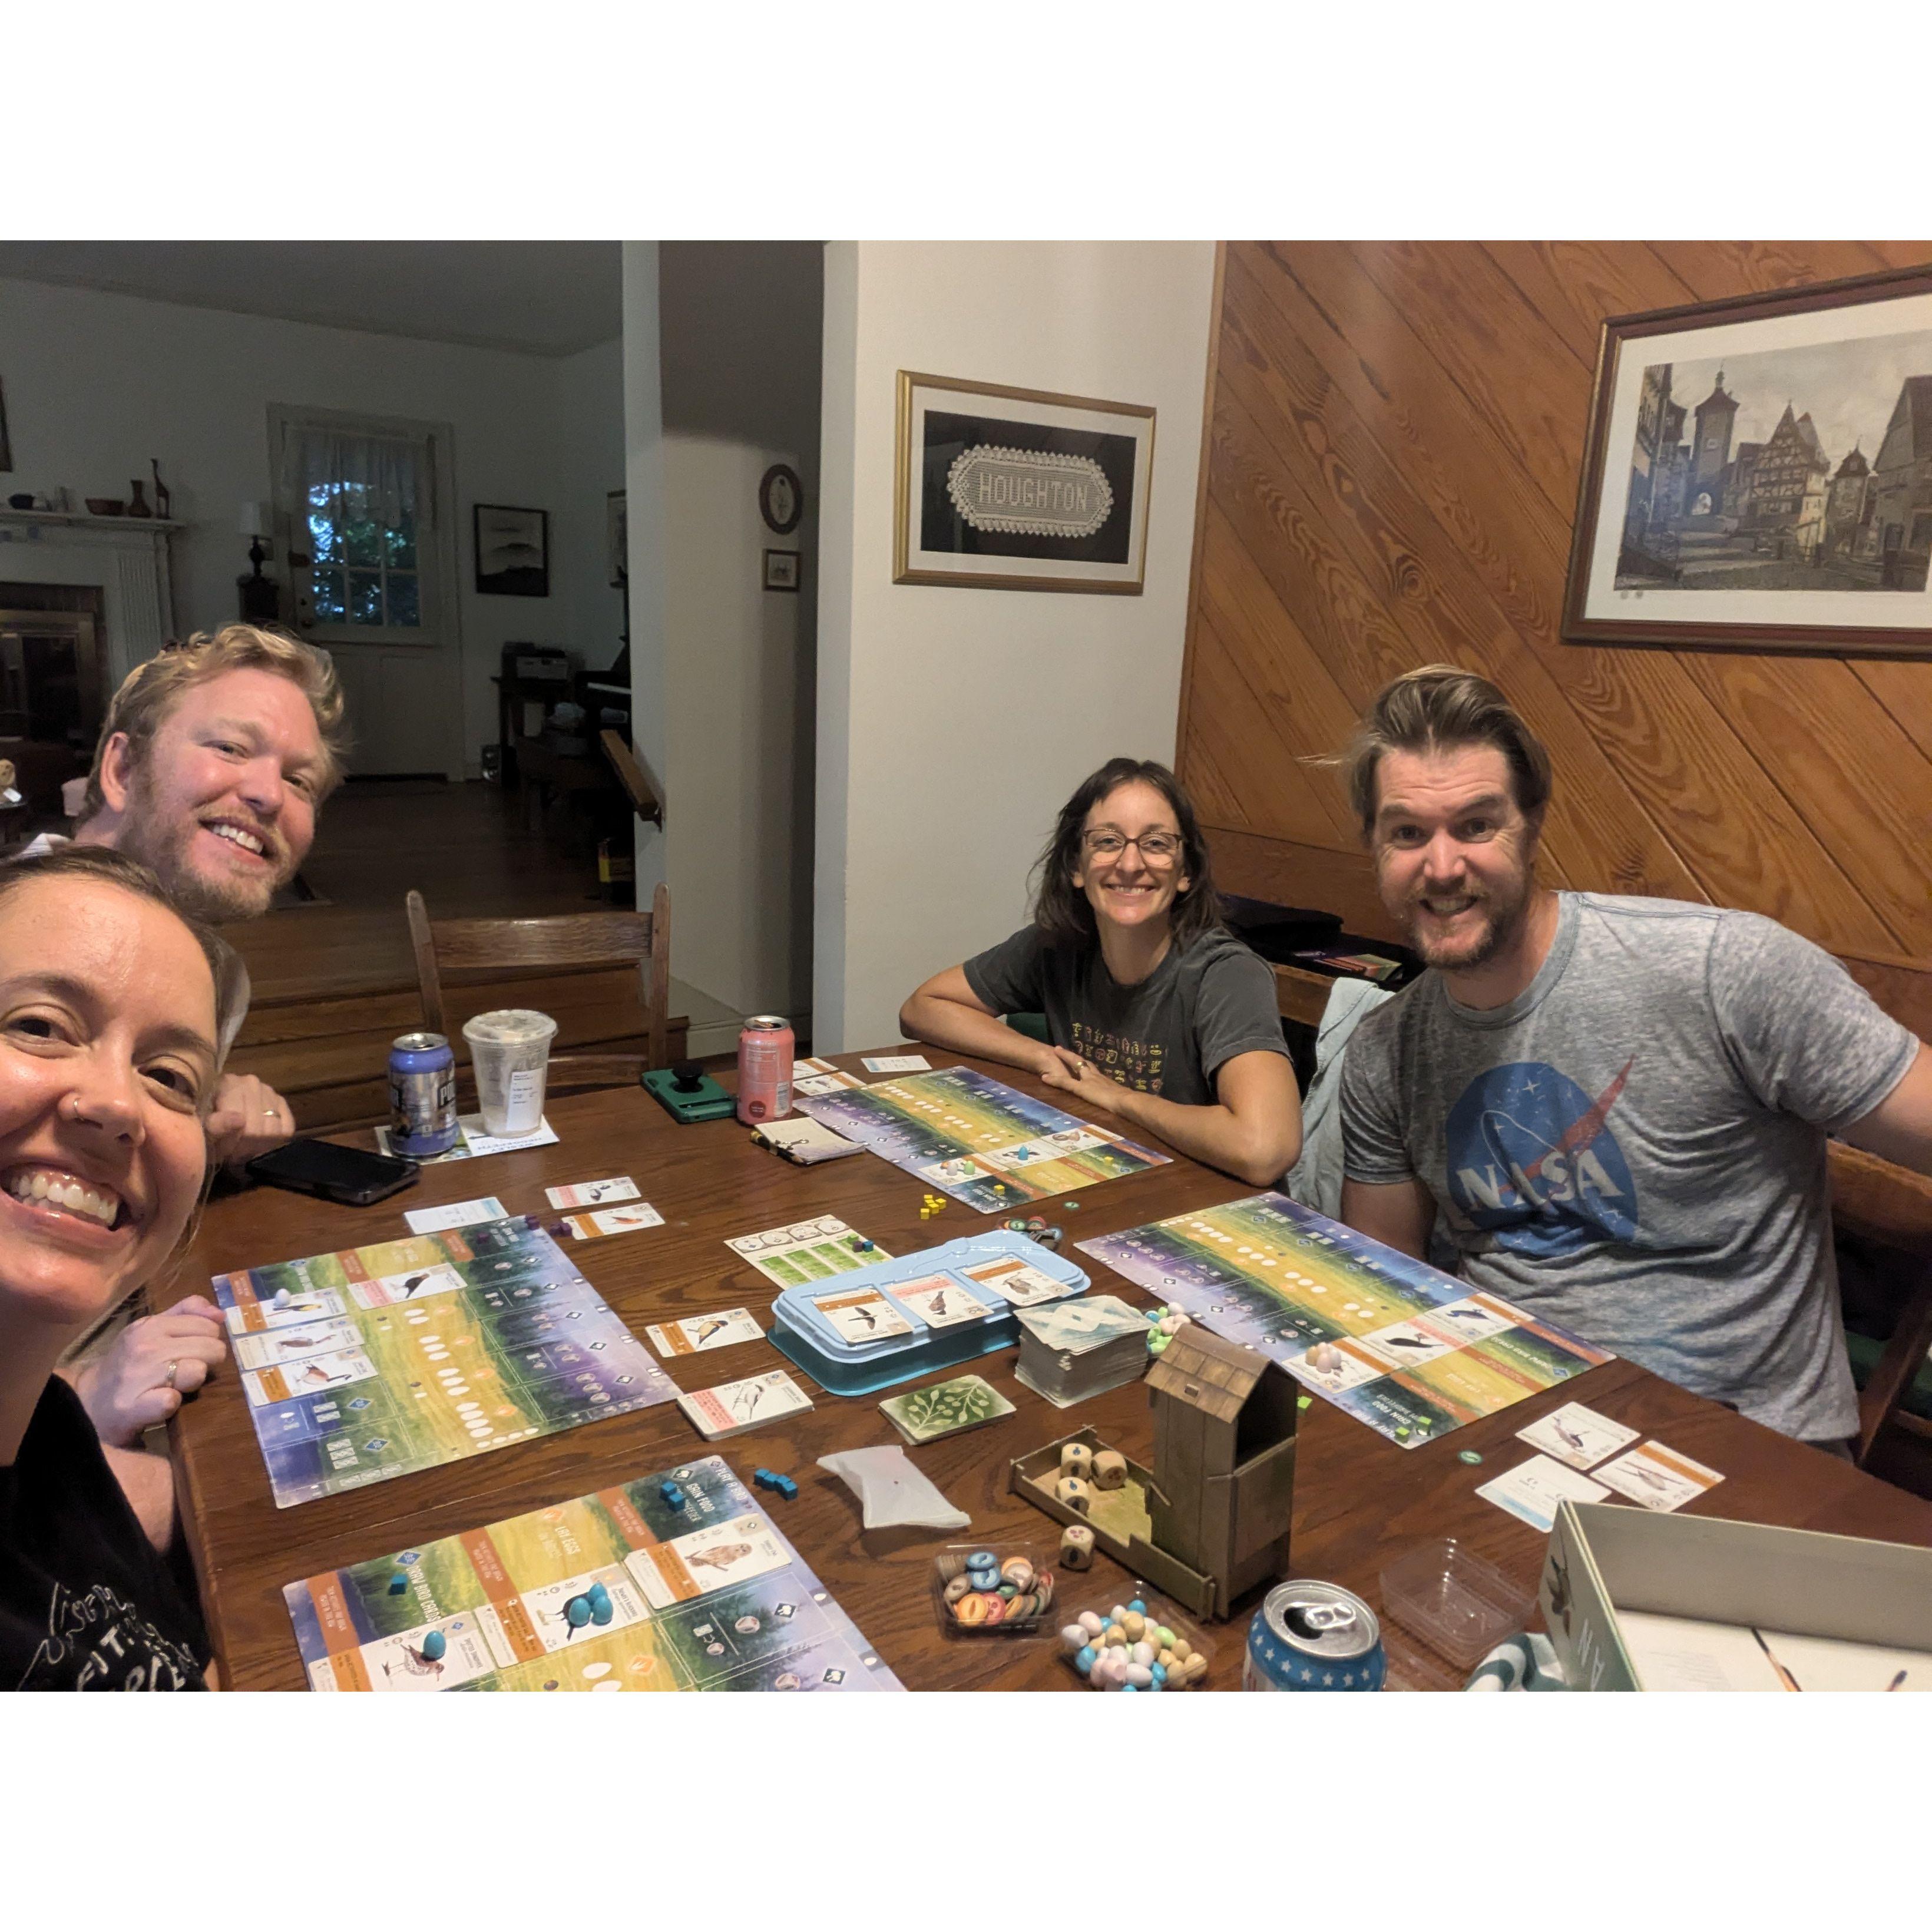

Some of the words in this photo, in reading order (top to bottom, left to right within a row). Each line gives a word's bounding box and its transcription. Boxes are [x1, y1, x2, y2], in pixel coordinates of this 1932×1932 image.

[980, 472, 1087, 512] HOUGHTON
[1457, 1149, 1625, 1209] NASA
[715, 1467, 735, 1482] PLAY
[730, 1488, 748, 1501] BIRD
[686, 1483, 706, 1499] GAIN
[697, 1497, 716, 1512] FOOD
[555, 1526, 570, 1537] LAY
[406, 1564, 425, 1584] DRAW
[414, 1583, 432, 1600] BIRD
[421, 1600, 442, 1622] CARDS
